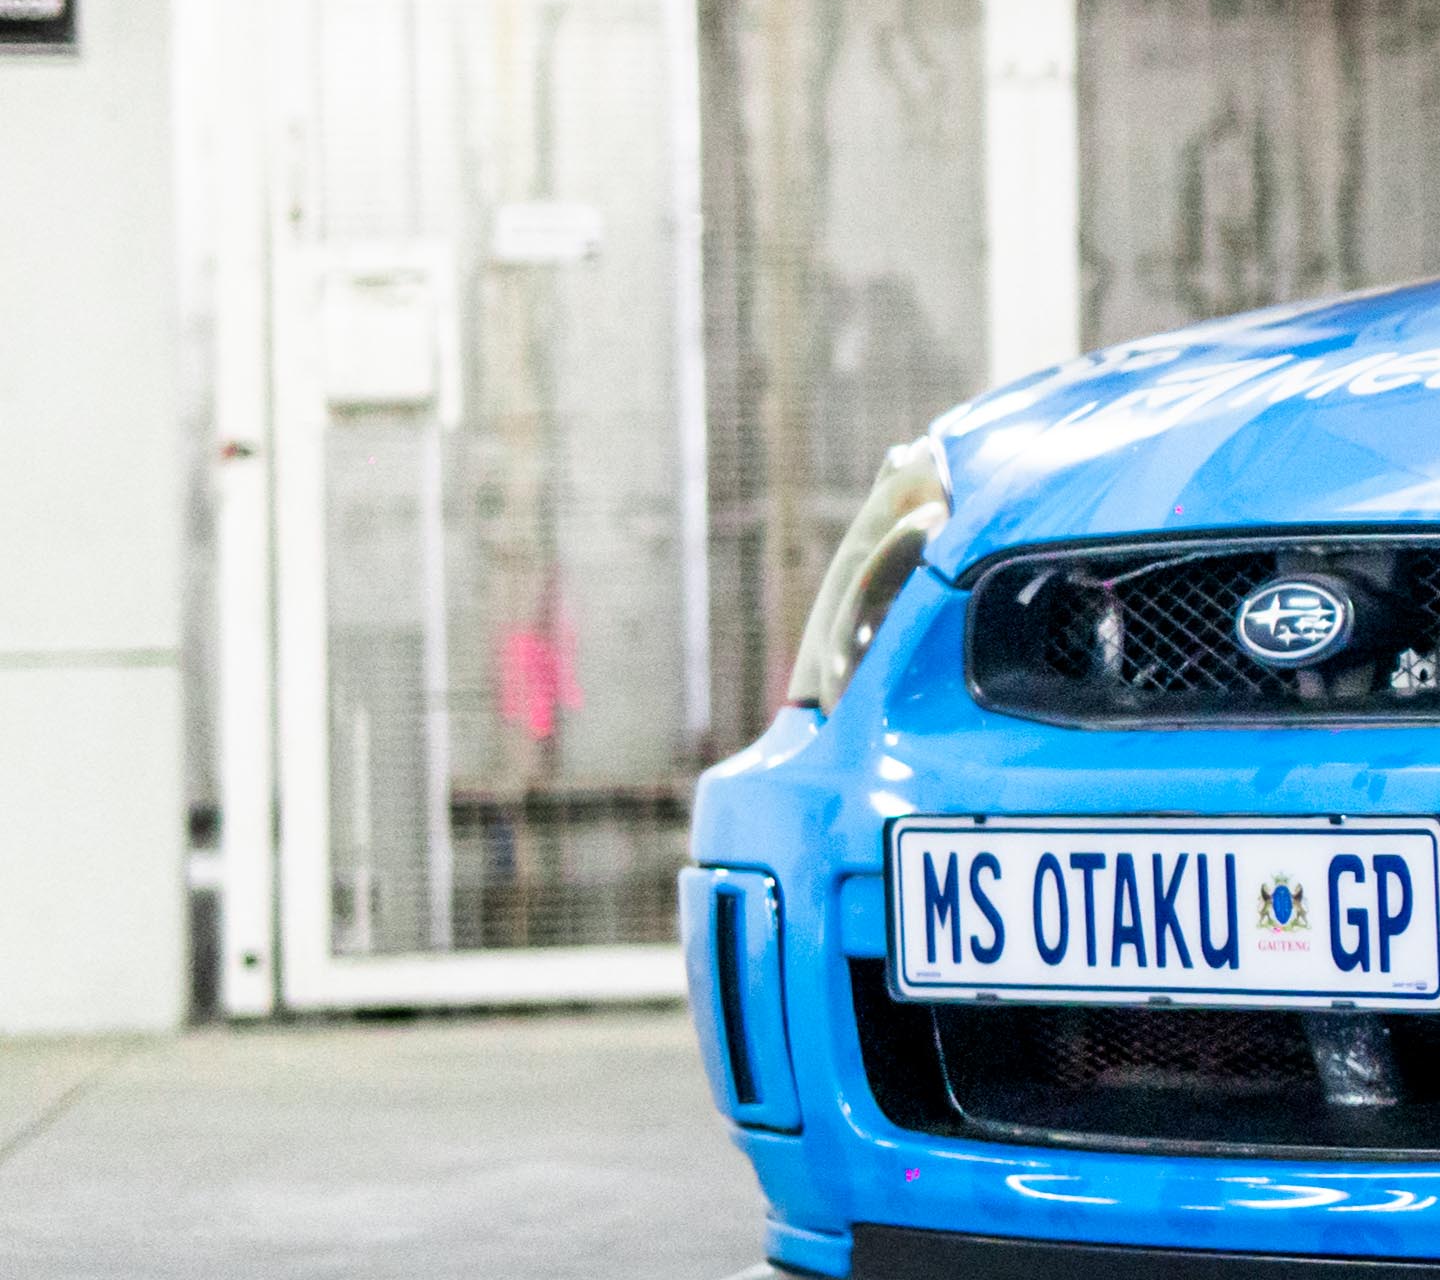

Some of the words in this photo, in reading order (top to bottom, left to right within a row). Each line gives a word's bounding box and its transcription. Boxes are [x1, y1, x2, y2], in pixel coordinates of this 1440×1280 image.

[922, 851, 1005, 964] MS
[1033, 852, 1240, 970] OTAKU
[1327, 853, 1413, 974] GP
